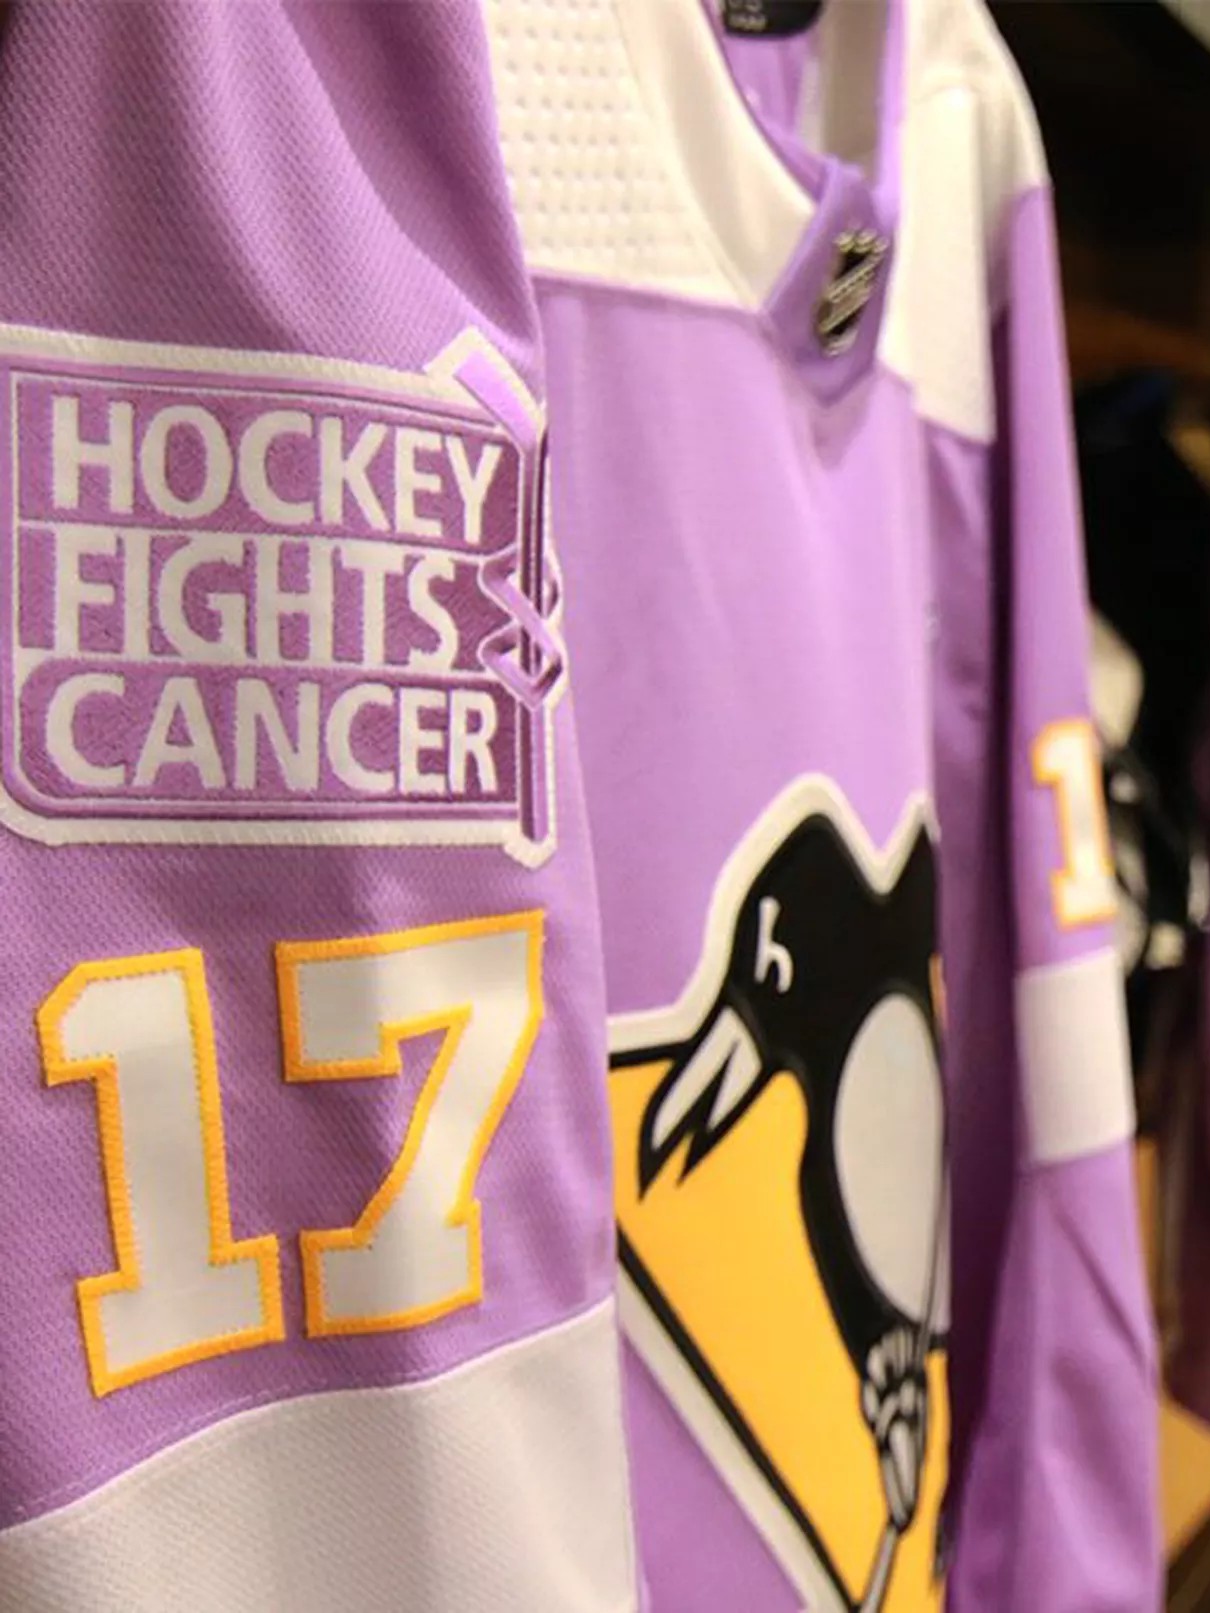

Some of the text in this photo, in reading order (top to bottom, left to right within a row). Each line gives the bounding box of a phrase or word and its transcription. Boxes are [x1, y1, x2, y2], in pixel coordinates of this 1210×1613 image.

[51, 394, 500, 546] HOCKEY
[54, 526, 460, 672] FIGHTS
[45, 671, 499, 795] CANCER
[34, 909, 546, 1399] 17
